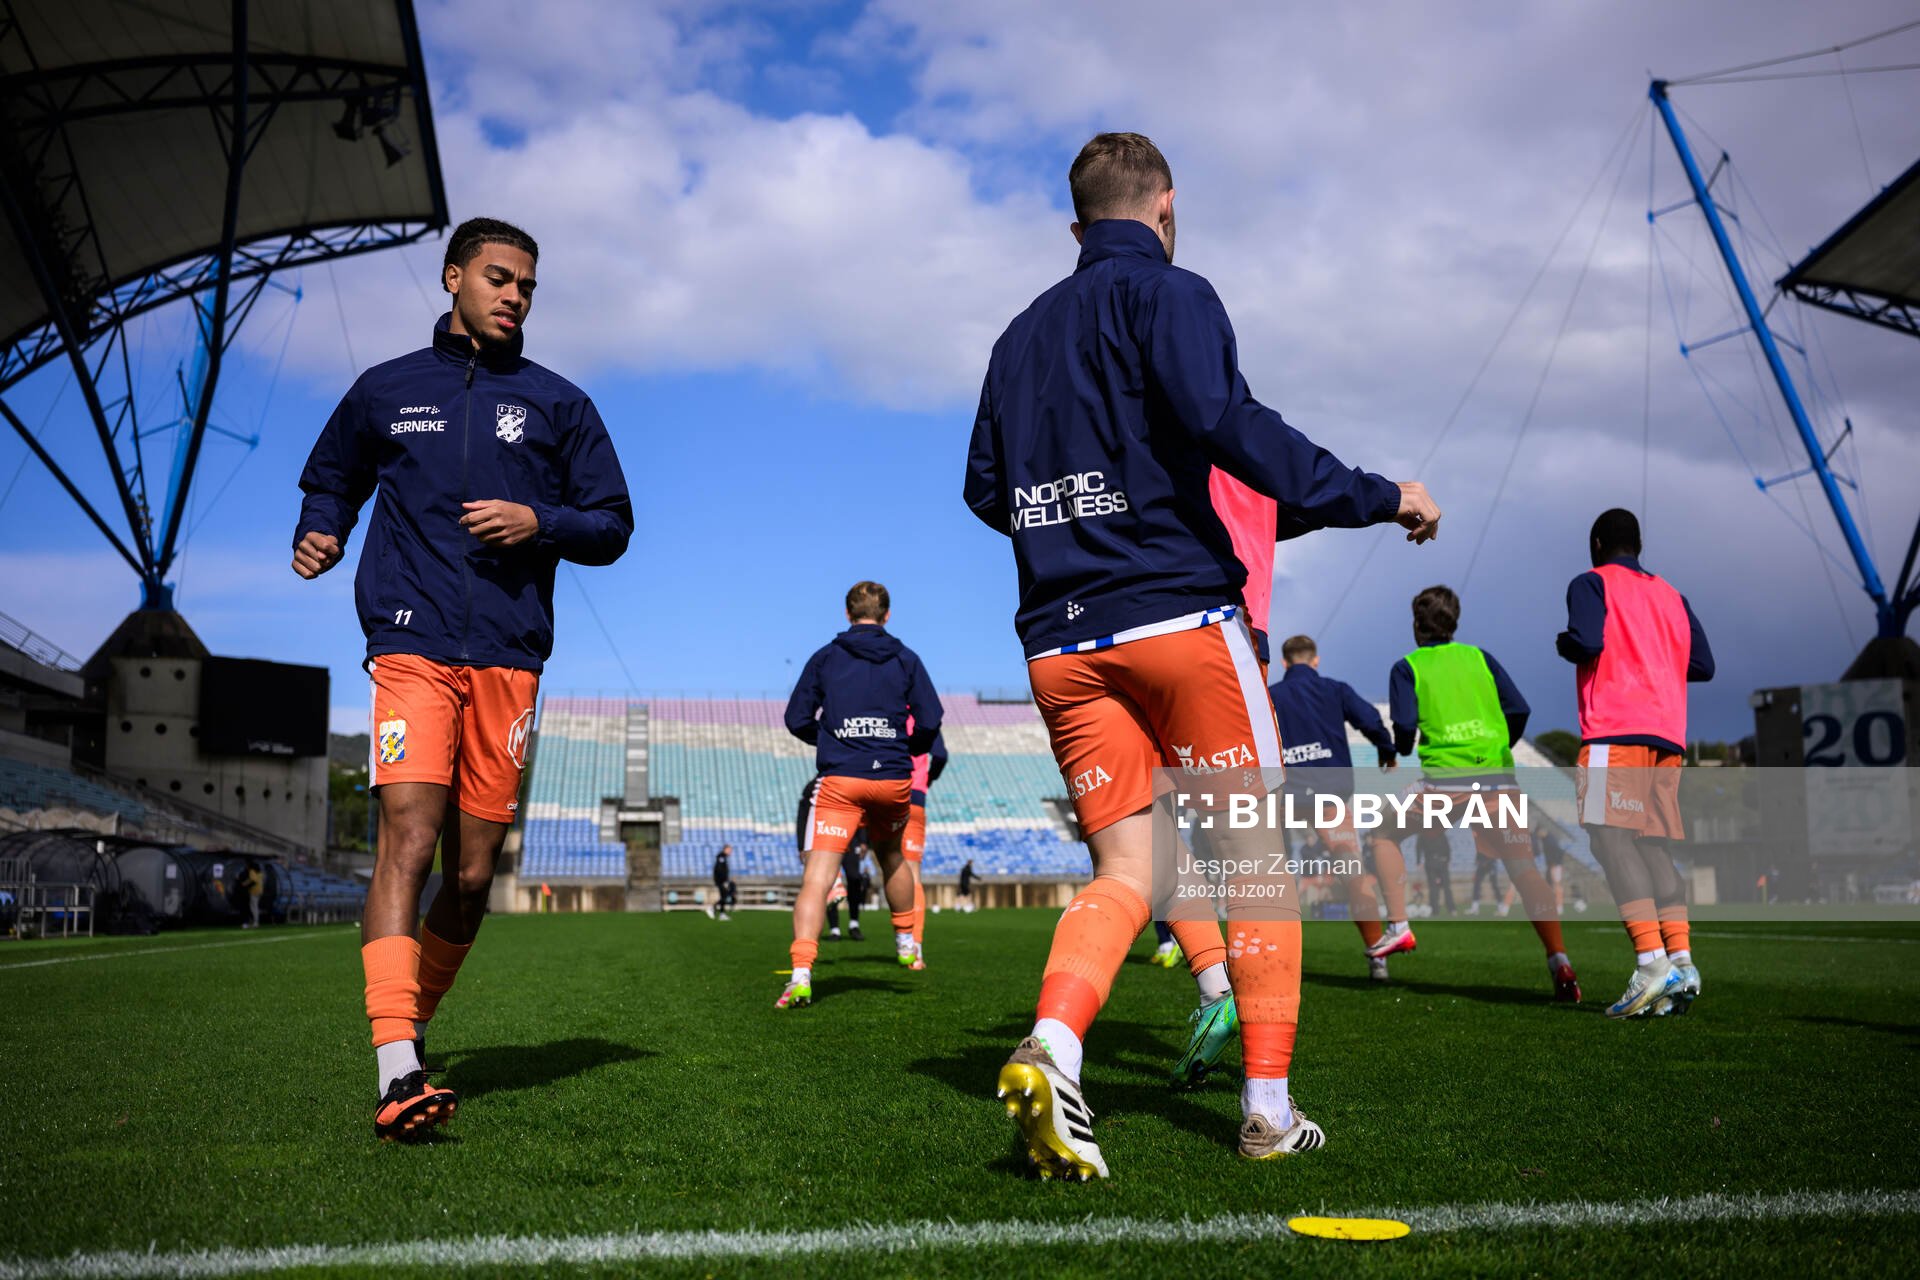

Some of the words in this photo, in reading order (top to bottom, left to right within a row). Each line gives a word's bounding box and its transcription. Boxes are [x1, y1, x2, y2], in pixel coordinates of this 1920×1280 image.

[400, 406, 431, 414] CRAFT
[390, 421, 445, 435] SERNEKE
[1014, 471, 1105, 508] NORDIC
[394, 609, 413, 625] 11
[843, 717, 889, 729] NORDIC
[834, 727, 897, 739] WELLNESS
[1802, 710, 1907, 769] 20
[1179, 743, 1255, 776] RASTA
[1070, 765, 1113, 800] ASTA
[816, 824, 848, 839] RASTA
